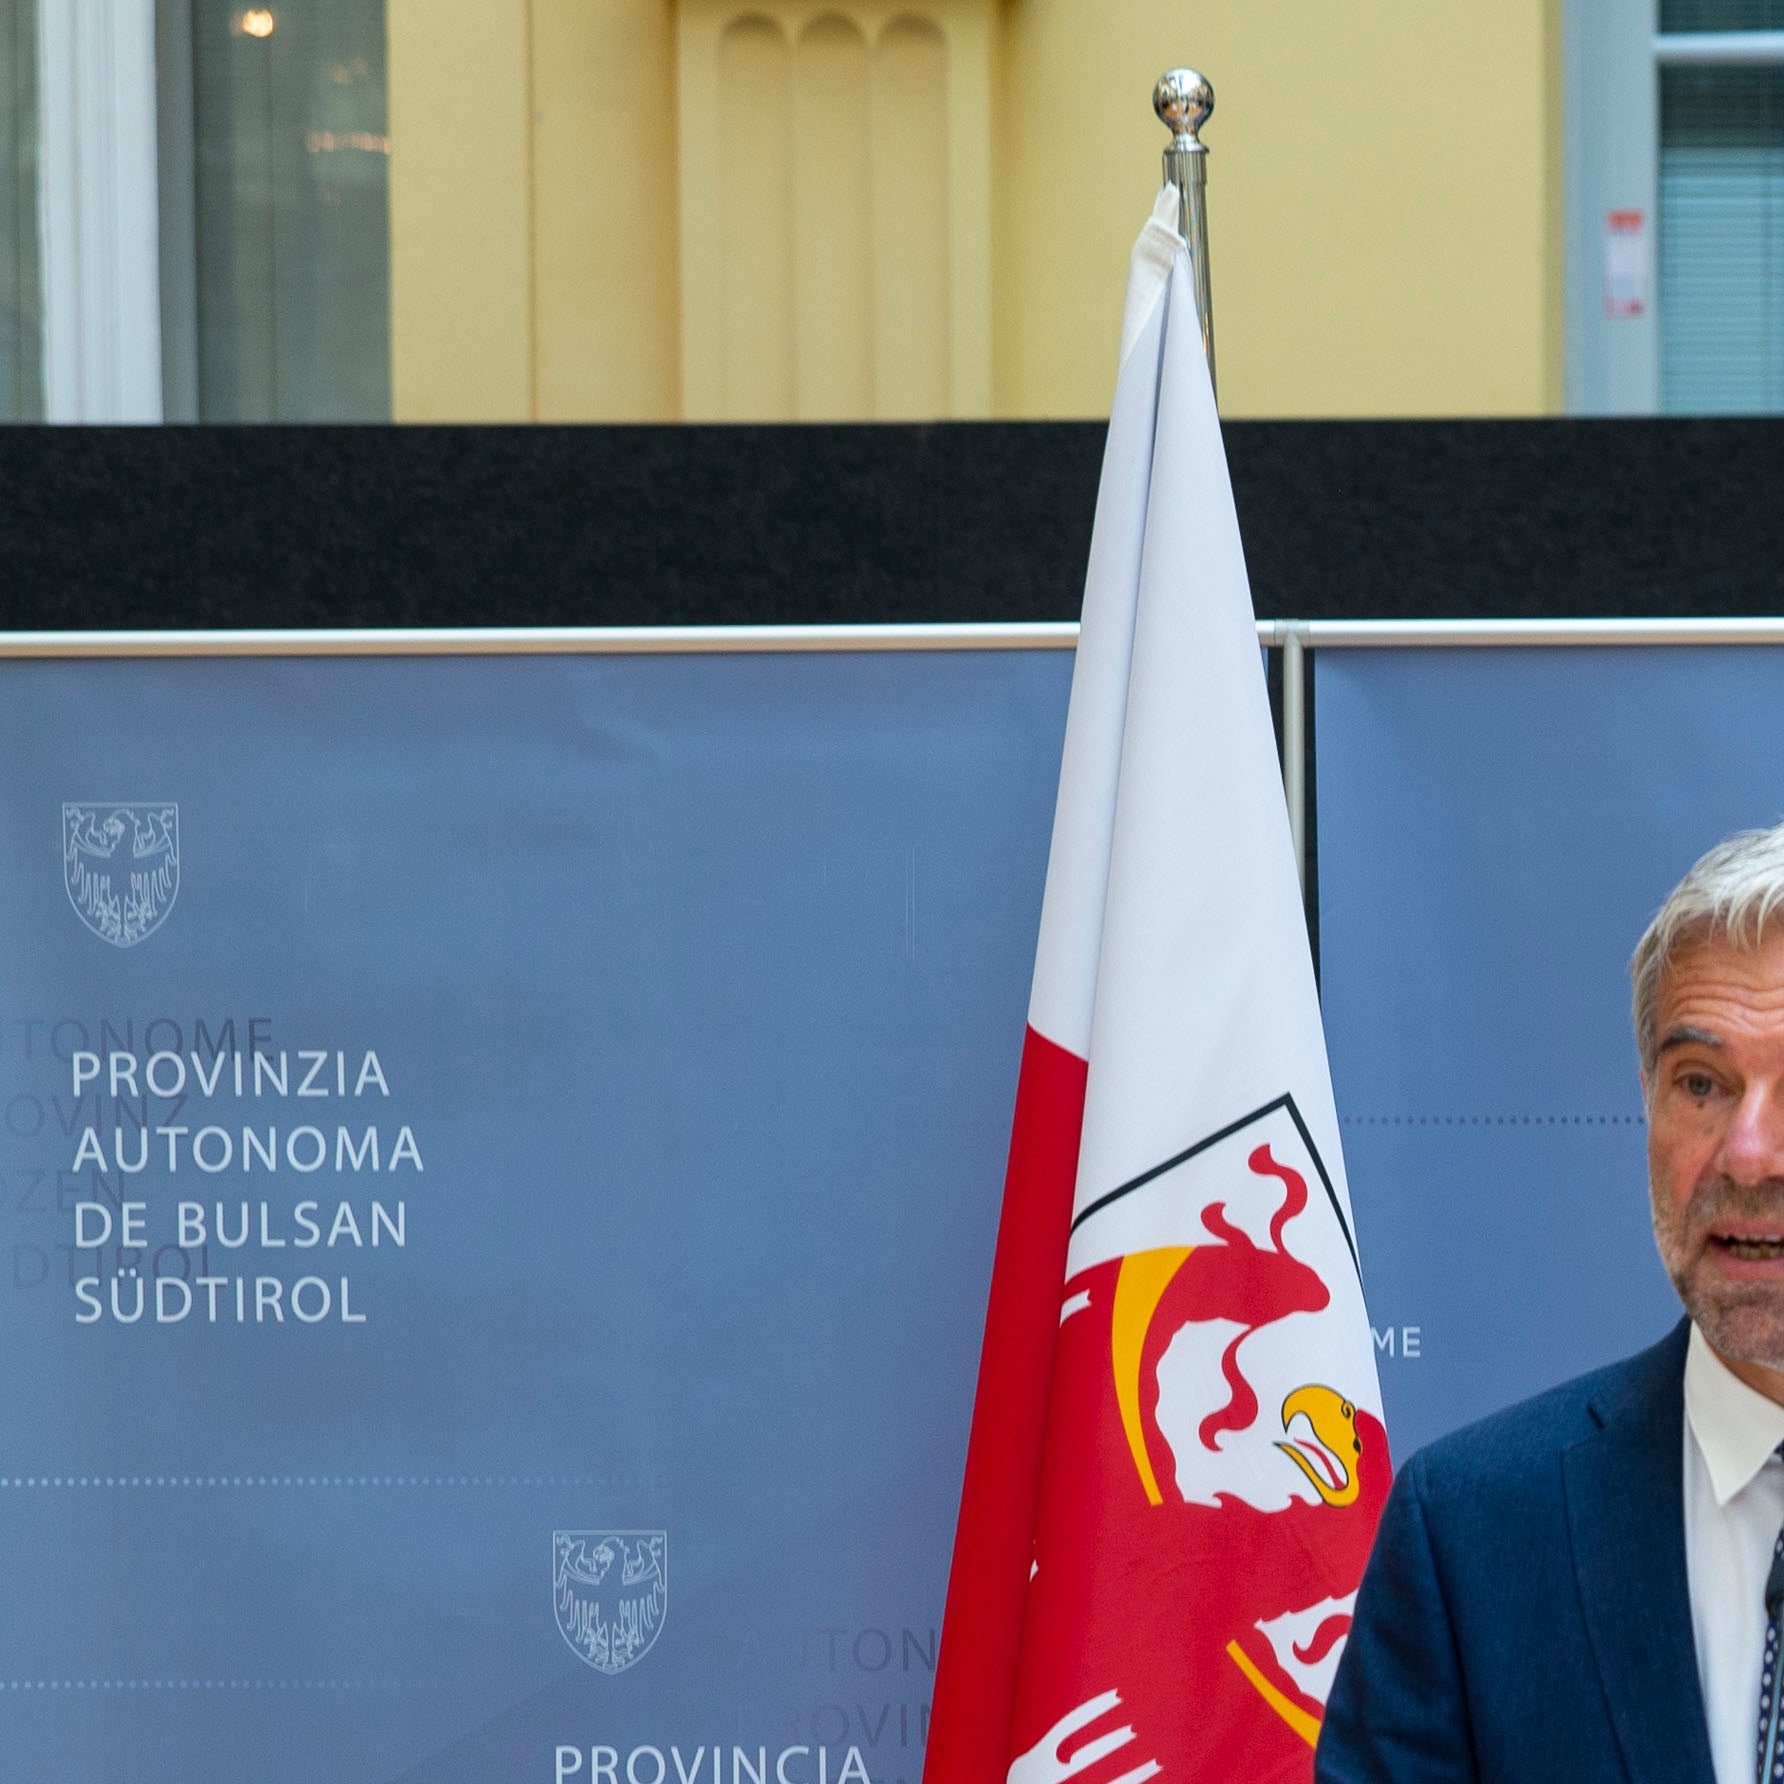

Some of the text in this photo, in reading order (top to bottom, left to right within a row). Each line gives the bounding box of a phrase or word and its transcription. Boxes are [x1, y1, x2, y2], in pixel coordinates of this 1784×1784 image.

[72, 1051, 390, 1097] PROVINZIA
[72, 1126, 425, 1173] AUTONOMA
[74, 1201, 406, 1248] DE BULSAN
[74, 1268, 366, 1323] SÜDTIROL
